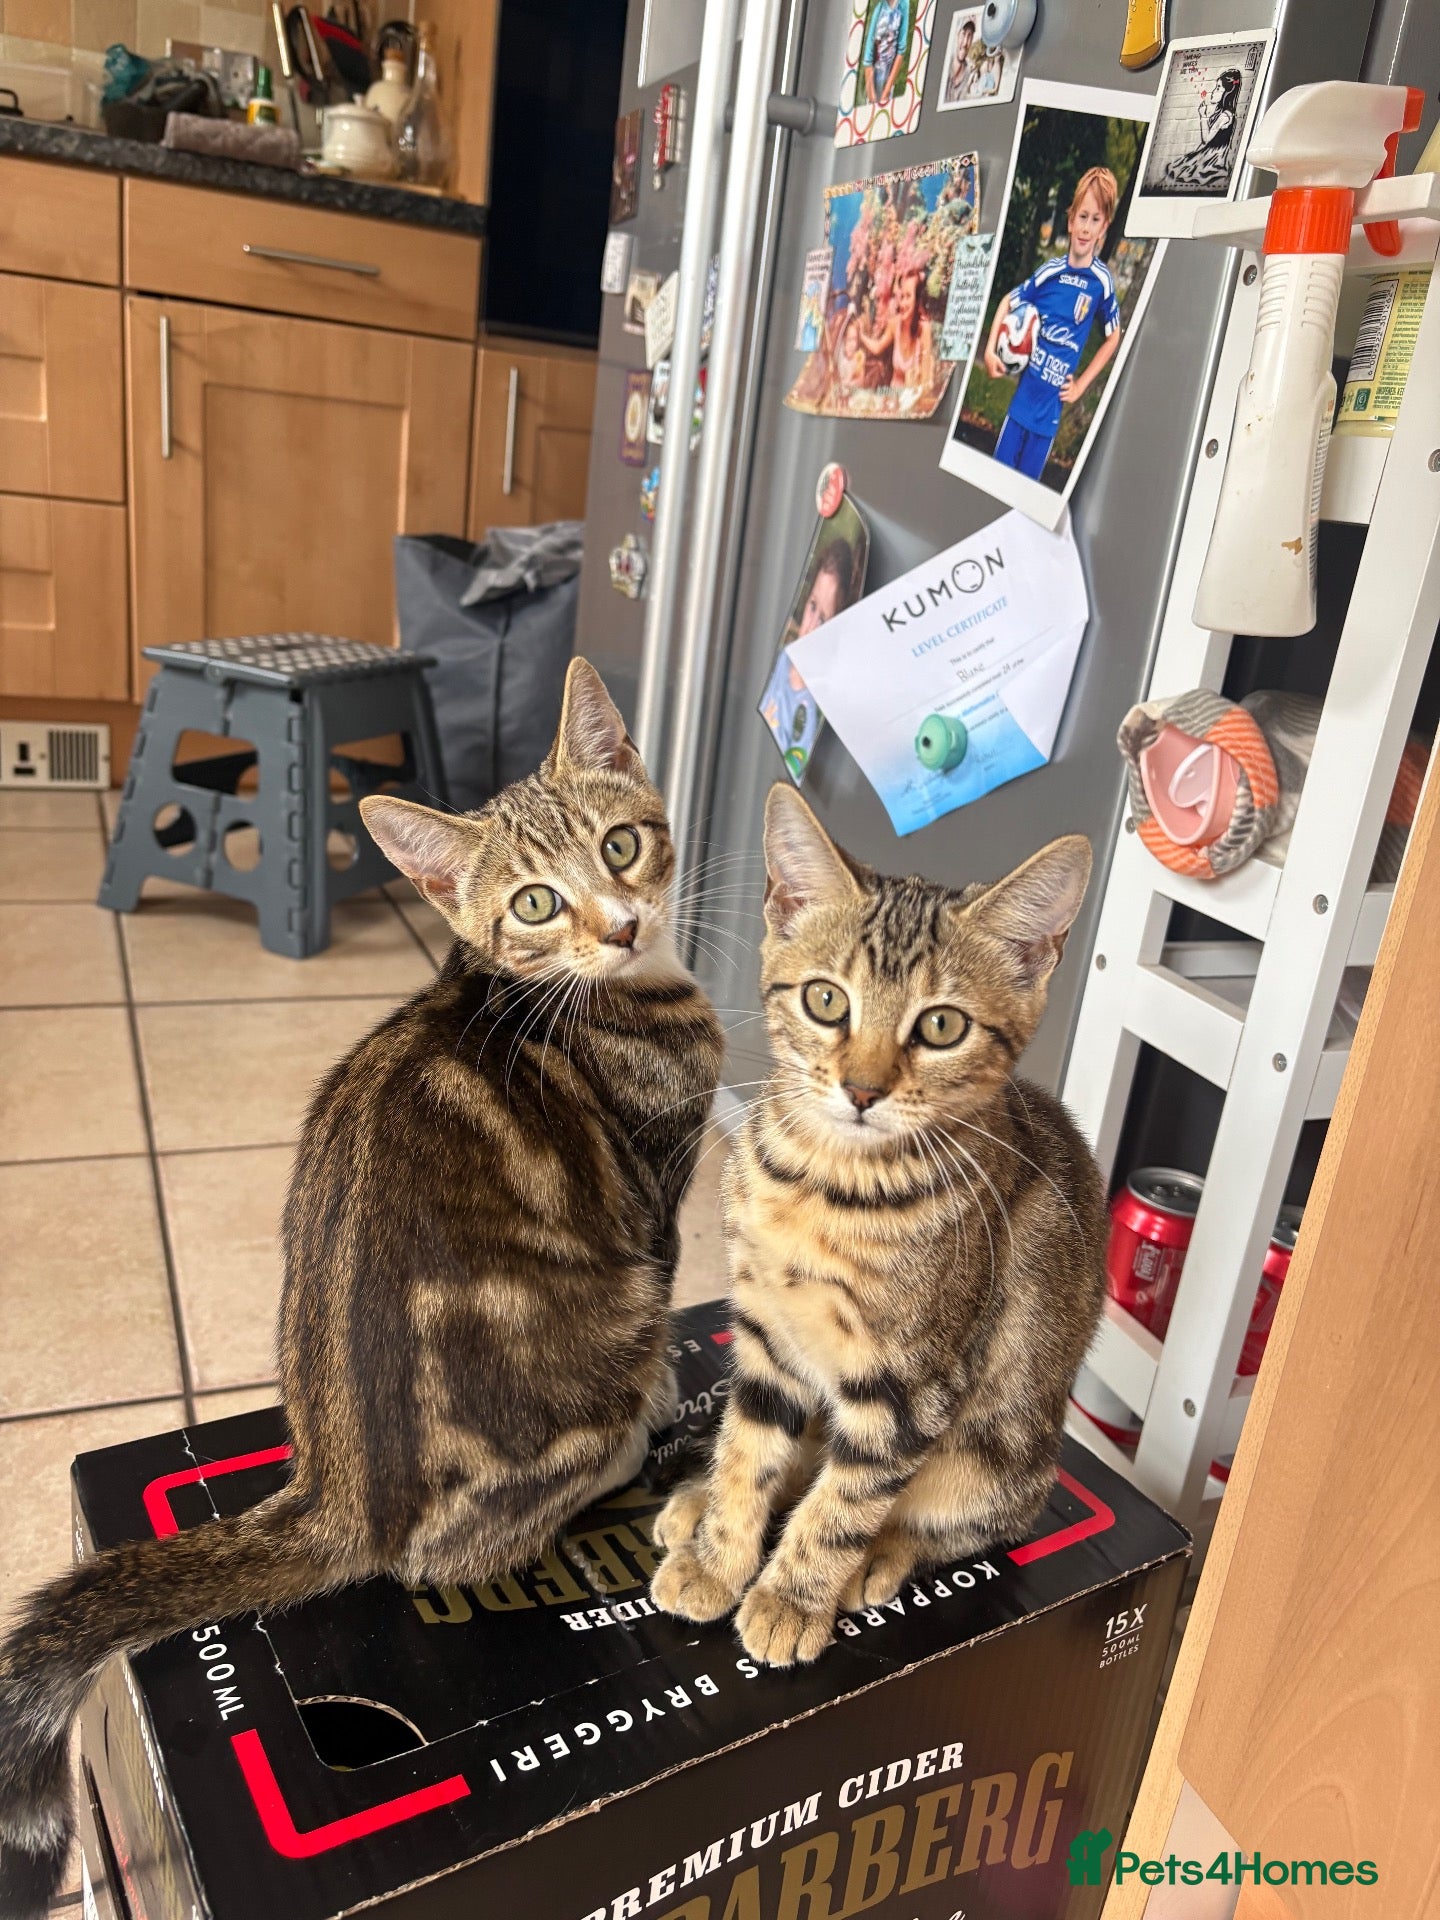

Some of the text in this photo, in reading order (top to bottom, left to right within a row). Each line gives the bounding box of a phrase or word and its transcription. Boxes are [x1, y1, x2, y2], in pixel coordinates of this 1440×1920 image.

[882, 547, 1005, 633] KUMON
[911, 595, 1009, 658] LEVEL CERTIFICATE
[559, 1597, 664, 1632] IDER
[1101, 1633, 1140, 1658] 500ML
[1106, 1603, 1148, 1639] 15X
[192, 1624, 245, 1721] 500ML
[489, 1560, 1000, 1782] KOPPARBS BRYGGERI
[1099, 1644, 1139, 1669] BOTTLES
[838, 1742, 965, 1809] CIDER
[656, 1751, 1075, 1920] ARBERG
